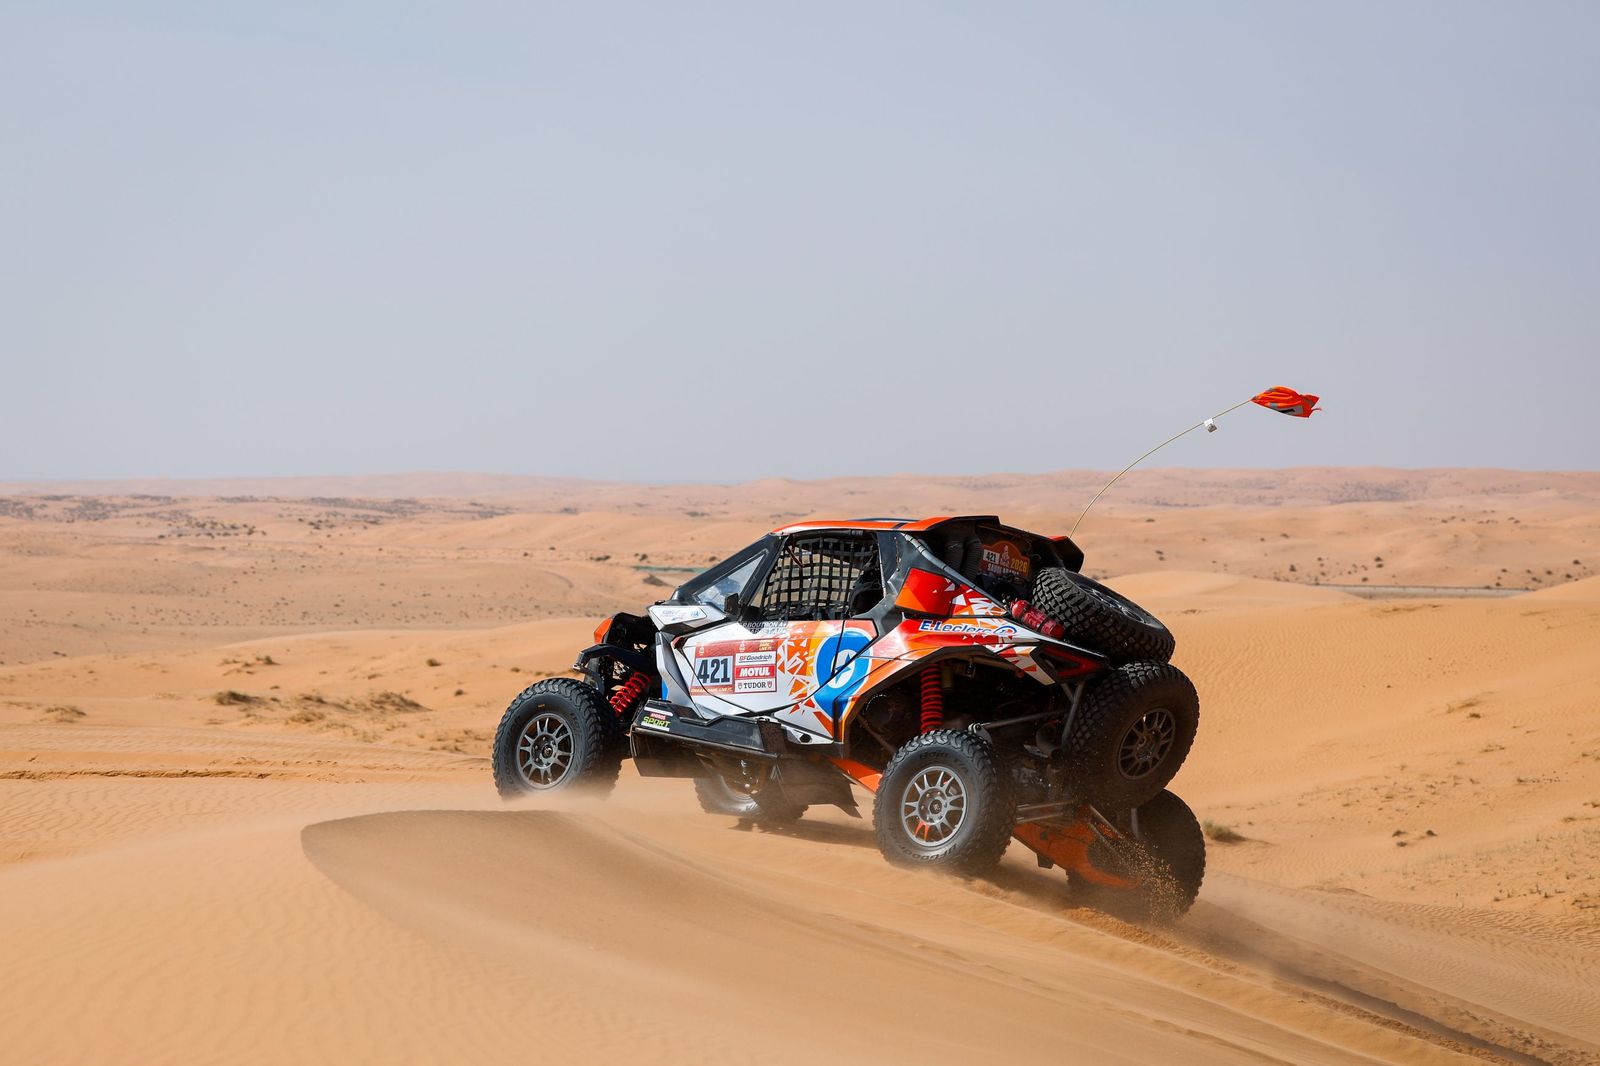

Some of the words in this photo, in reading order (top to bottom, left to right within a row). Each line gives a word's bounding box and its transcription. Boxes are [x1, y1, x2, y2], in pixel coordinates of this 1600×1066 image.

[986, 552, 996, 562] 421
[920, 620, 992, 634] E.Leclerc
[697, 658, 731, 684] 421
[739, 667, 771, 677] MOTUL
[643, 716, 671, 727] SPORT
